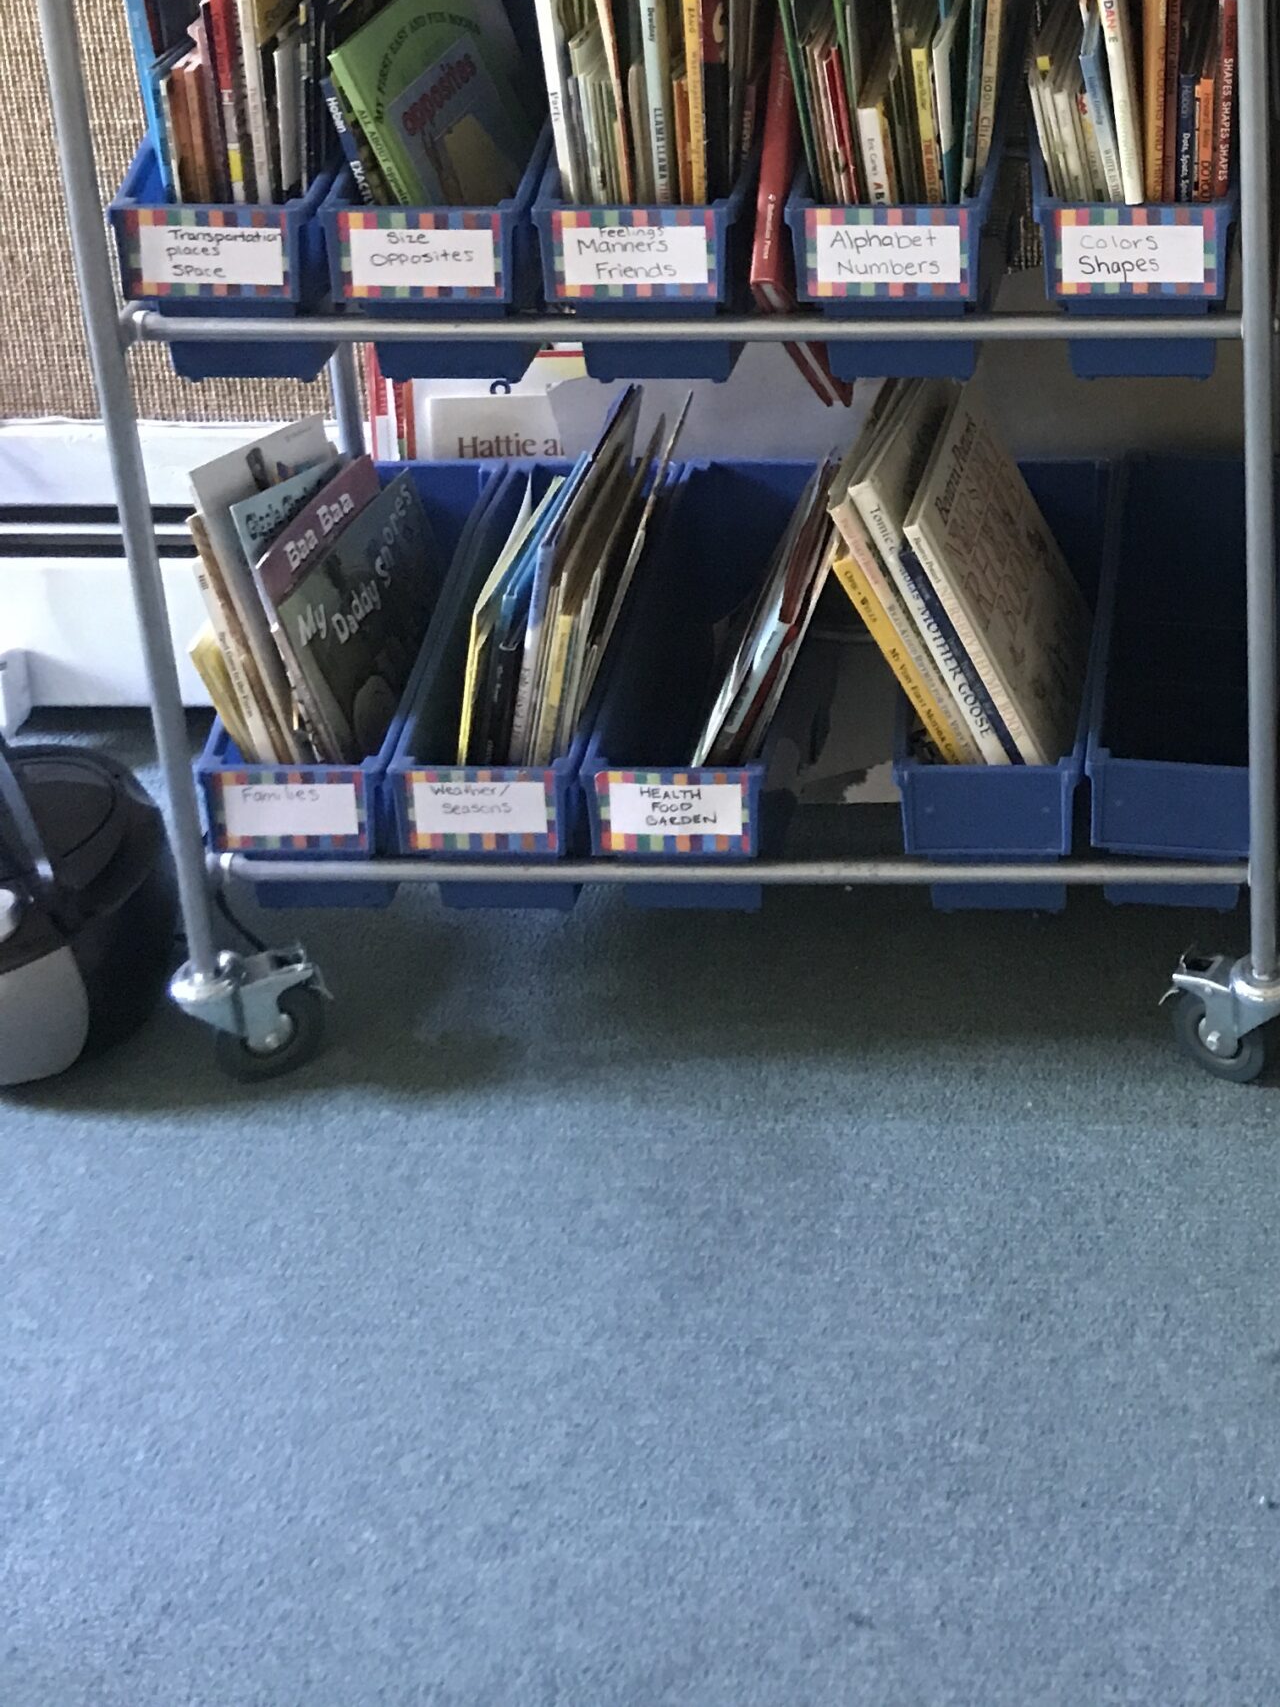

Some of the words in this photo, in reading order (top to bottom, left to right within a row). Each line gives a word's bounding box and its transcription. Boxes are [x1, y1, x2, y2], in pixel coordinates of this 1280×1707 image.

[324, 94, 349, 134] Hoban
[168, 228, 284, 245] Transportation
[386, 230, 430, 246] Size
[830, 231, 938, 251] Alphabet
[1080, 233, 1159, 251] Colors
[577, 238, 669, 255] Manners
[595, 261, 677, 279] Friends
[837, 258, 941, 277] Numbers
[1079, 255, 1160, 282] Shapes
[457, 436, 537, 457] Hattie
[282, 528, 320, 573] Baa
[315, 492, 356, 537] Baa
[297, 602, 328, 647] My
[331, 578, 382, 644] Daddy
[954, 680, 994, 739] GOOSE
[639, 786, 702, 801] HEALTH
[650, 800, 693, 813] FOOD
